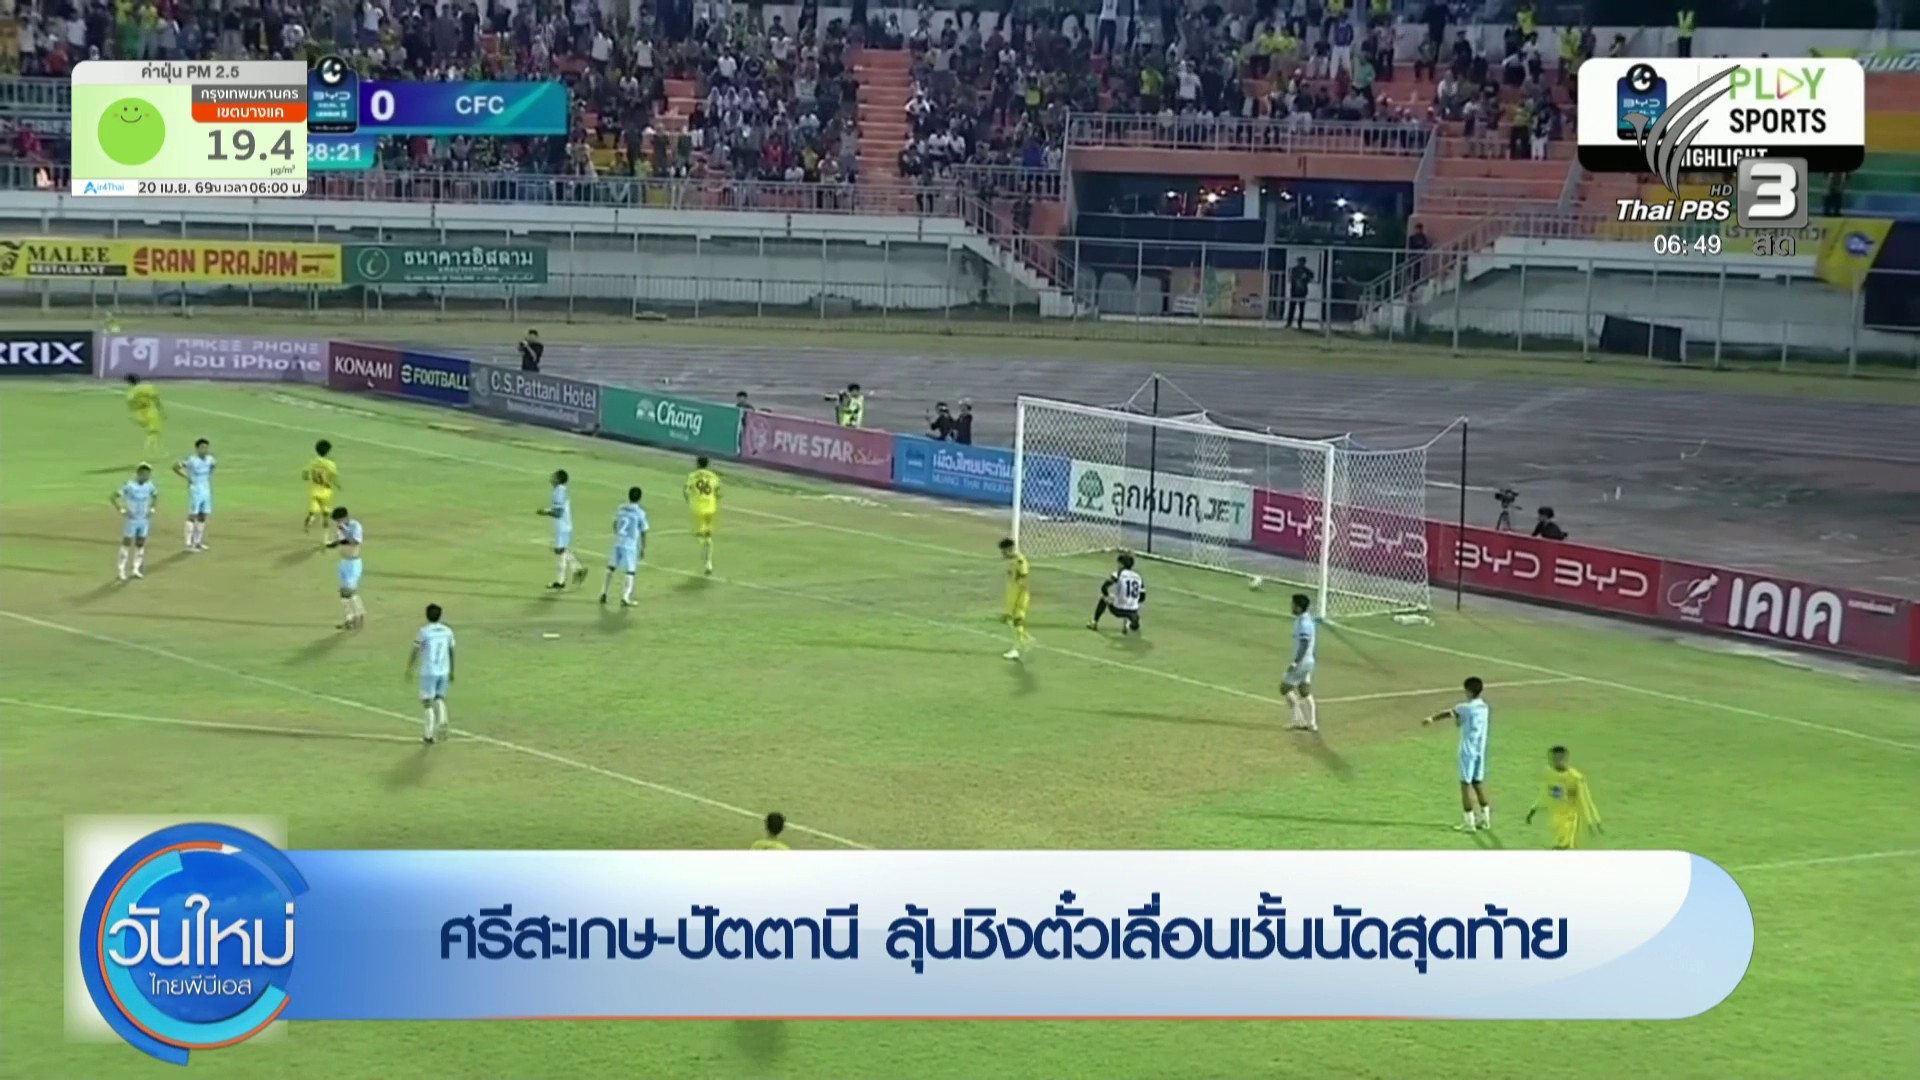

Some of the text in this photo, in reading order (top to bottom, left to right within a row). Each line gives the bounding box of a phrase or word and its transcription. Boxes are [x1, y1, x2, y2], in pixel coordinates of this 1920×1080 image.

[28, 247, 110, 263] MALEE
[151, 248, 195, 274] RAN
[234, 354, 322, 372] iPhone
[334, 356, 392, 380] KONAMI
[562, 383, 597, 409] Hotel
[656, 399, 703, 436] Chang
[774, 429, 809, 457] FIVE
[811, 434, 855, 464] STAR
[1204, 498, 1246, 523] JET
[1262, 506, 1649, 597] BYD BYD BYD BYD
[1124, 579, 1140, 599] 18
